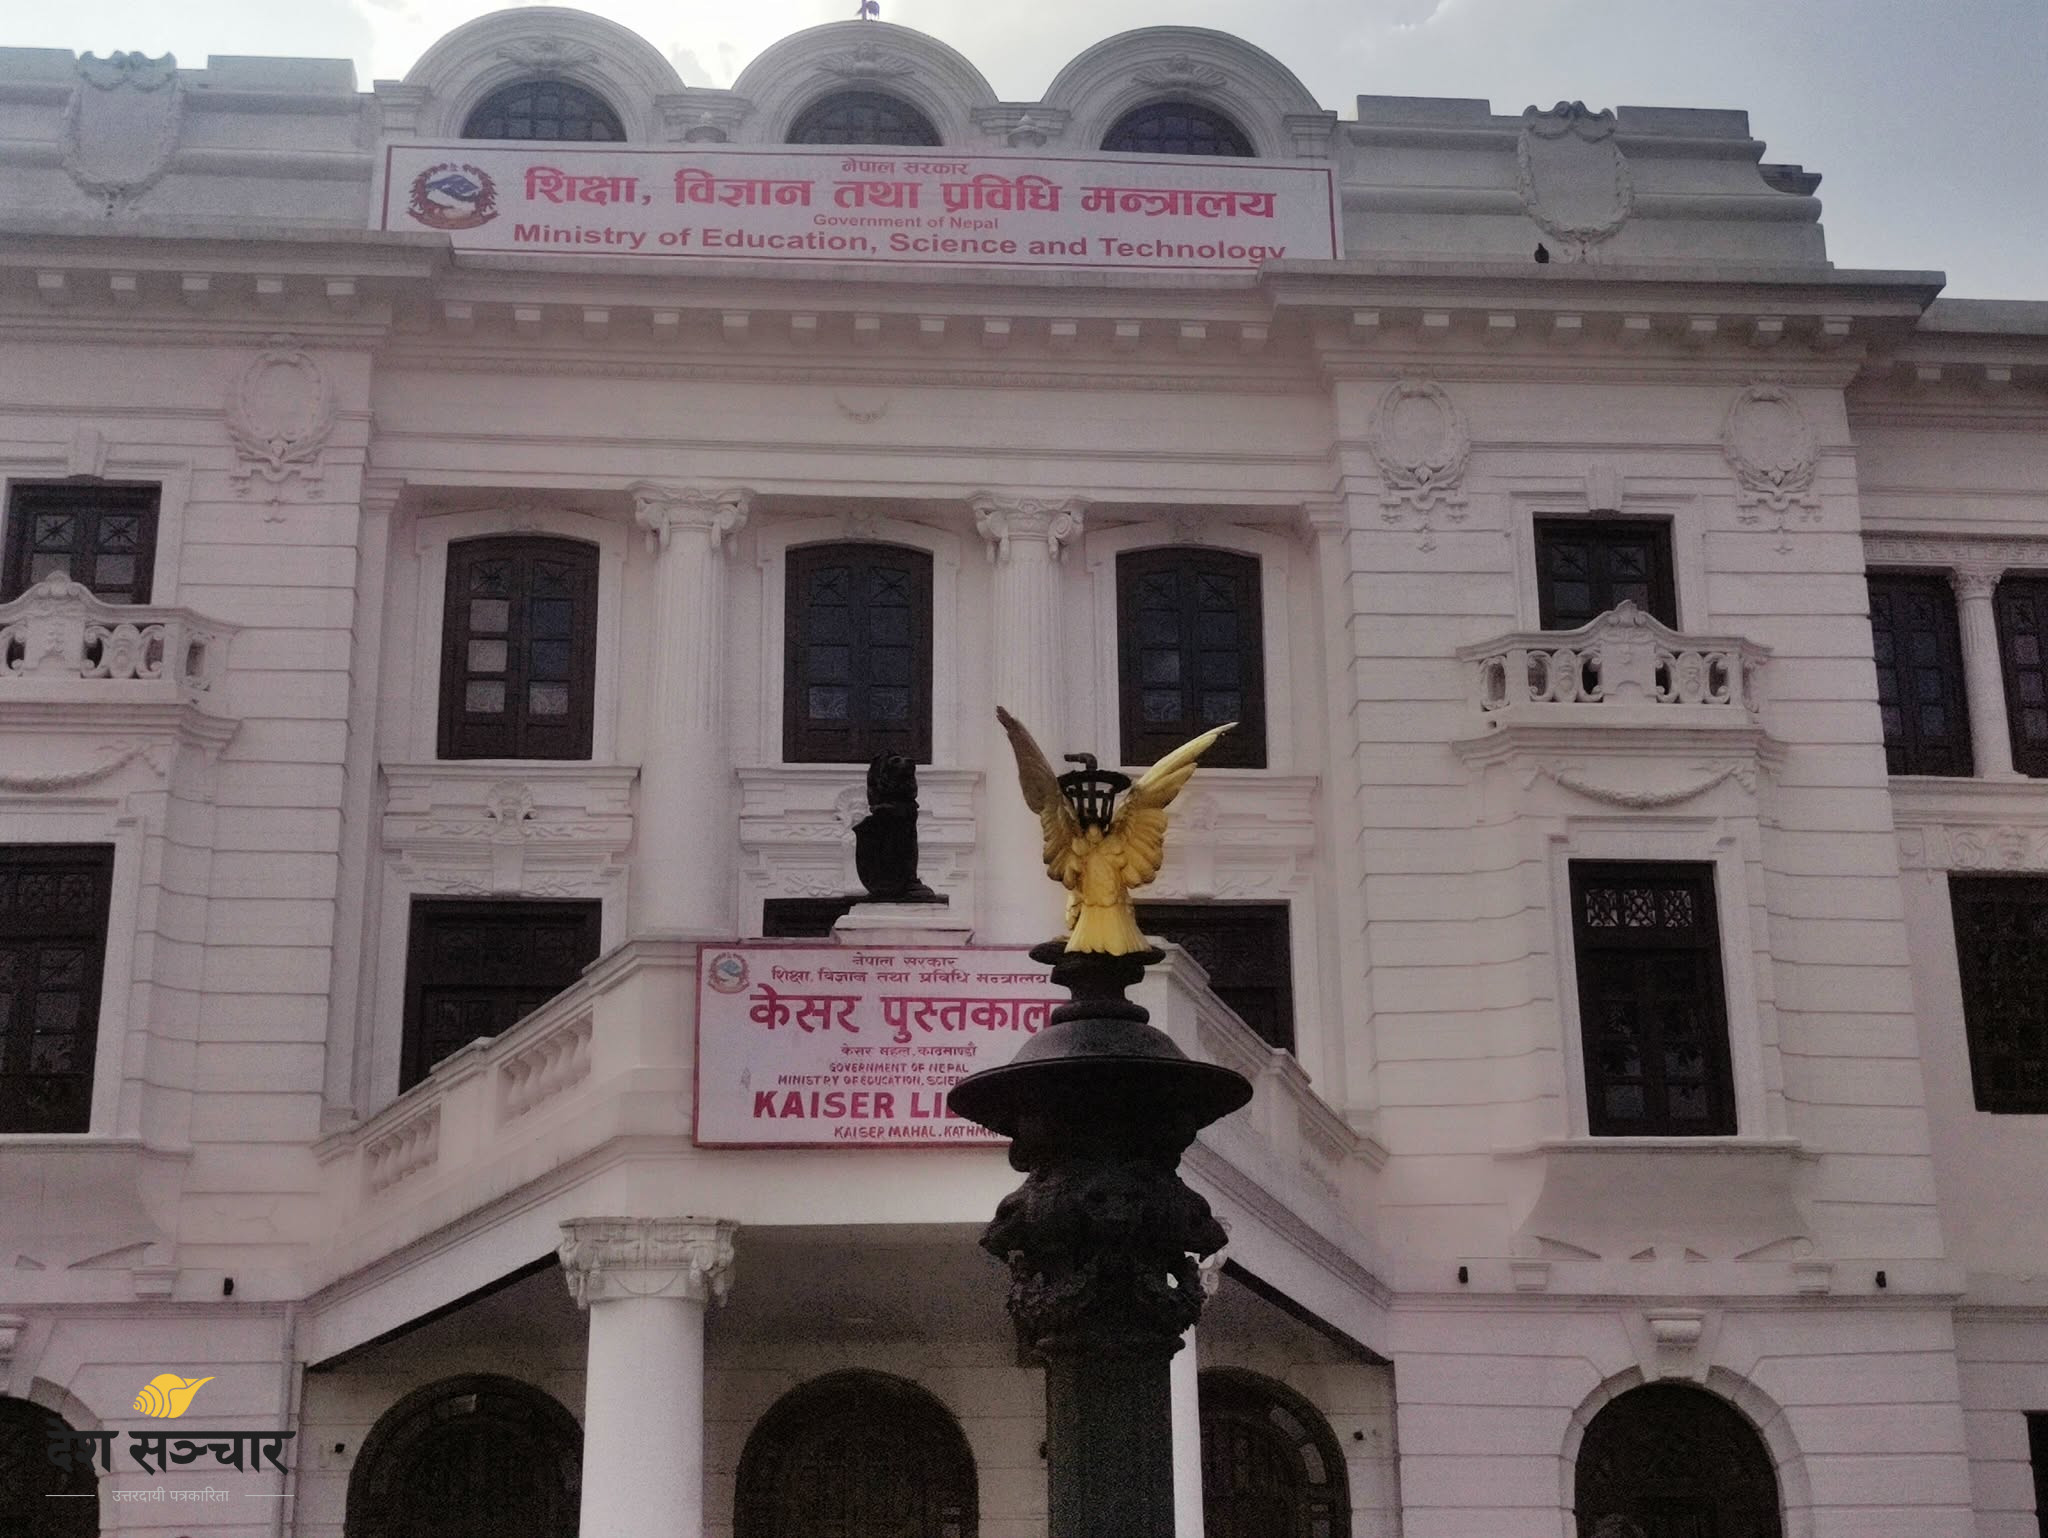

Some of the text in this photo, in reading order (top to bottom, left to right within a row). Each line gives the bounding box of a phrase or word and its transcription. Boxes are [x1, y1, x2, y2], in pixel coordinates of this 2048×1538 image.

[842, 158, 968, 176] नेपाल सरकार
[524, 166, 1278, 219] शिक्षा, विज्ञान तथा प्रविधि मन्त्रालय
[813, 213, 999, 232] Government of Nepal
[514, 224, 1285, 263] Ministry of Education, Science and Technology
[852, 952, 958, 967] नेपाल सरकार
[818, 967, 868, 983] विज्ञान
[876, 971, 911, 983] तथा
[919, 970, 970, 984] प्रविधि
[976, 973, 1049, 984] मन्त्रालय
[750, 983, 1070, 1043] केसर पुस्तकाल
[841, 1043, 872, 1056] केसर
[830, 1063, 969, 1073] GOVERNMENT OF NEPAL
[778, 1075, 839, 1086] MINISTRY
[753, 1091, 895, 1119] KAISER
[834, 1126, 885, 1139] KAISER
